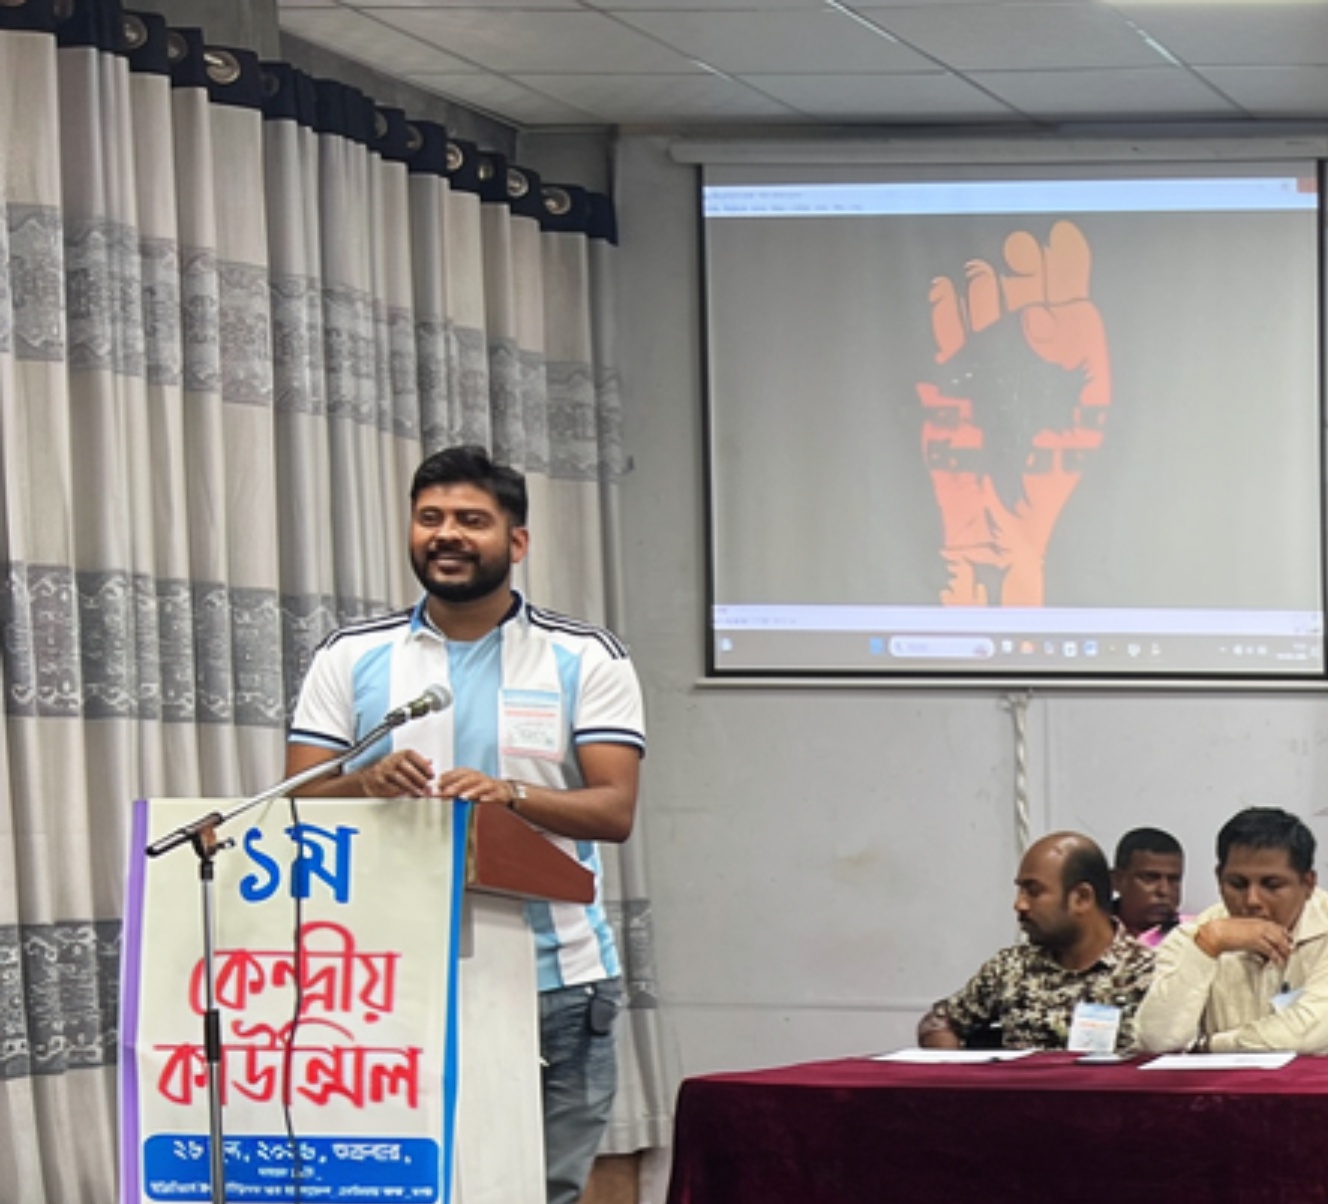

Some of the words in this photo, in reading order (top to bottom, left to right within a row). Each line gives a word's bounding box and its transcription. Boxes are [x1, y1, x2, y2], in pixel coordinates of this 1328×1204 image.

[239, 821, 360, 904] ১ম
[187, 919, 402, 1024] কেন্দ্রীয়
[152, 1016, 425, 1109] কাউন্সিল
